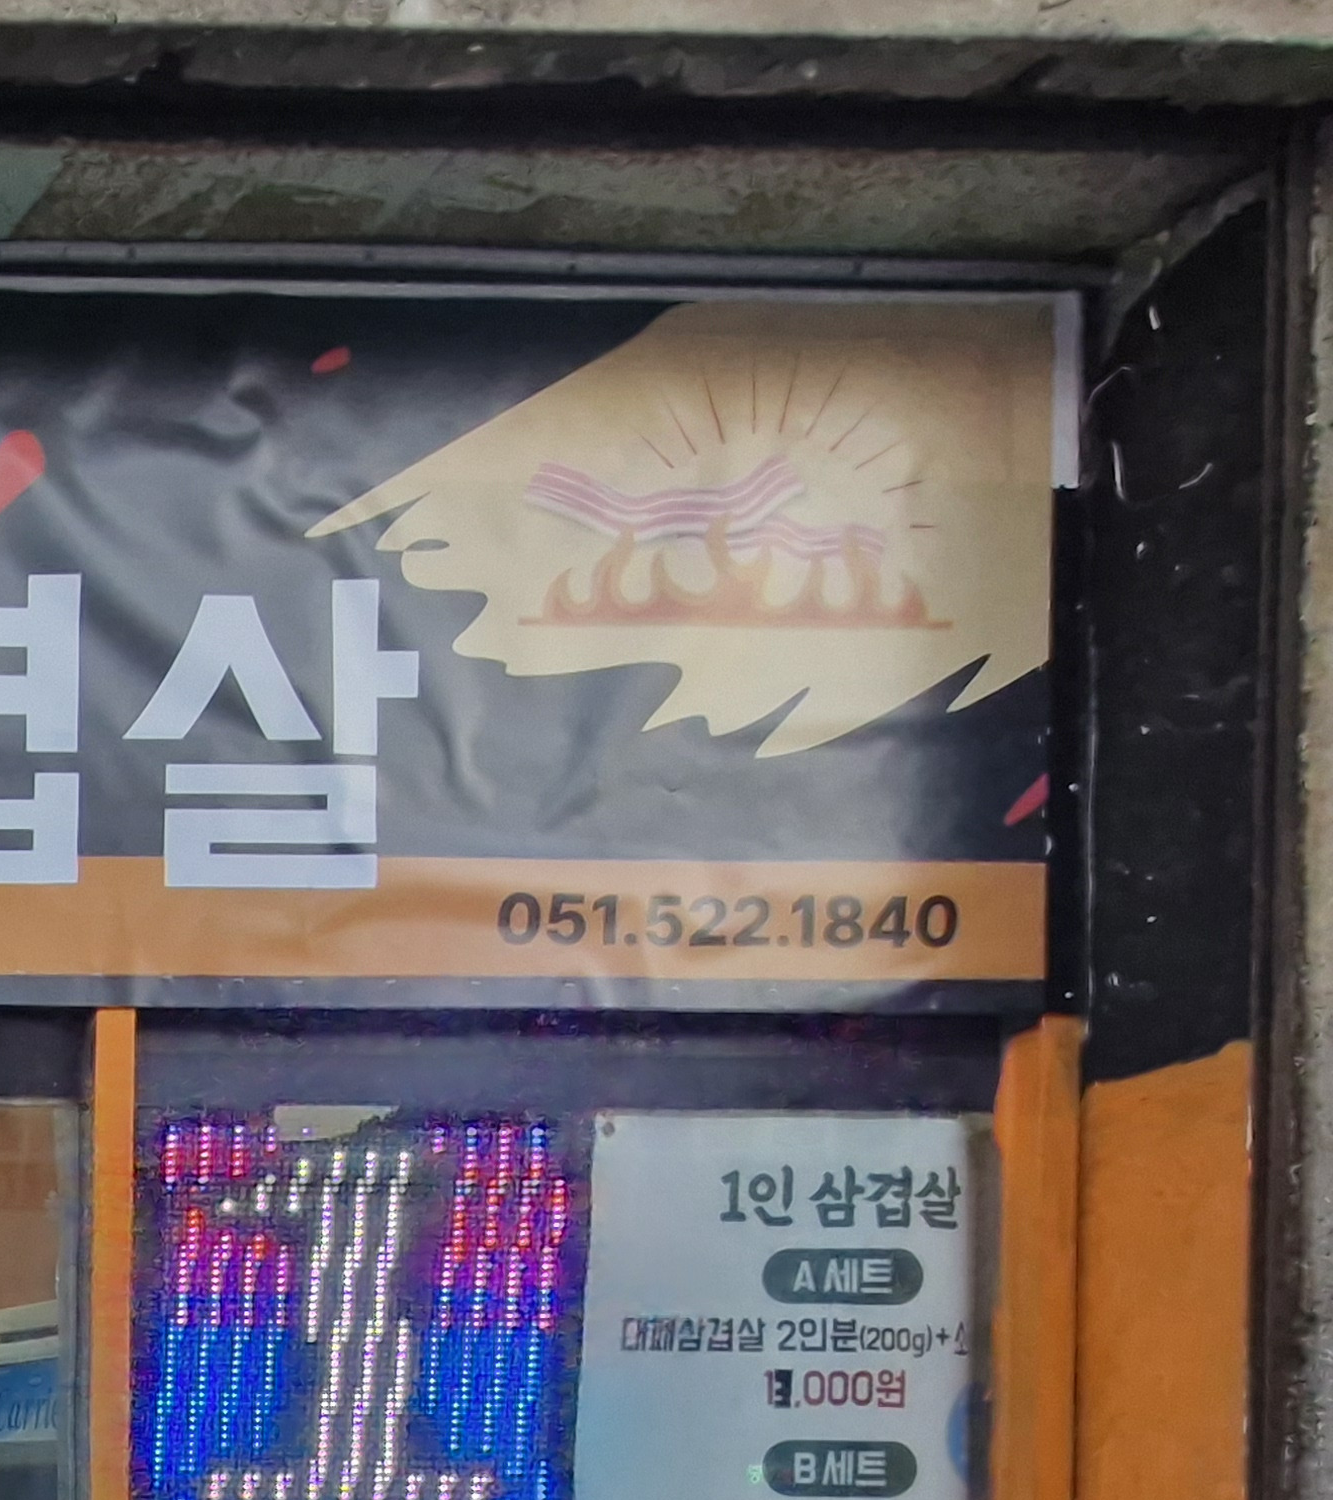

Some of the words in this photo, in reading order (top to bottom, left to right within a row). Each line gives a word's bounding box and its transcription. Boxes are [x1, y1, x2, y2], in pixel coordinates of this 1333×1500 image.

[496, 890, 958, 948] 051.522.1840
[720, 1164, 794, 1227] 1인
[809, 1165, 962, 1229] 삼겹살
[621, 1317, 766, 1353] 대패삼겹살
